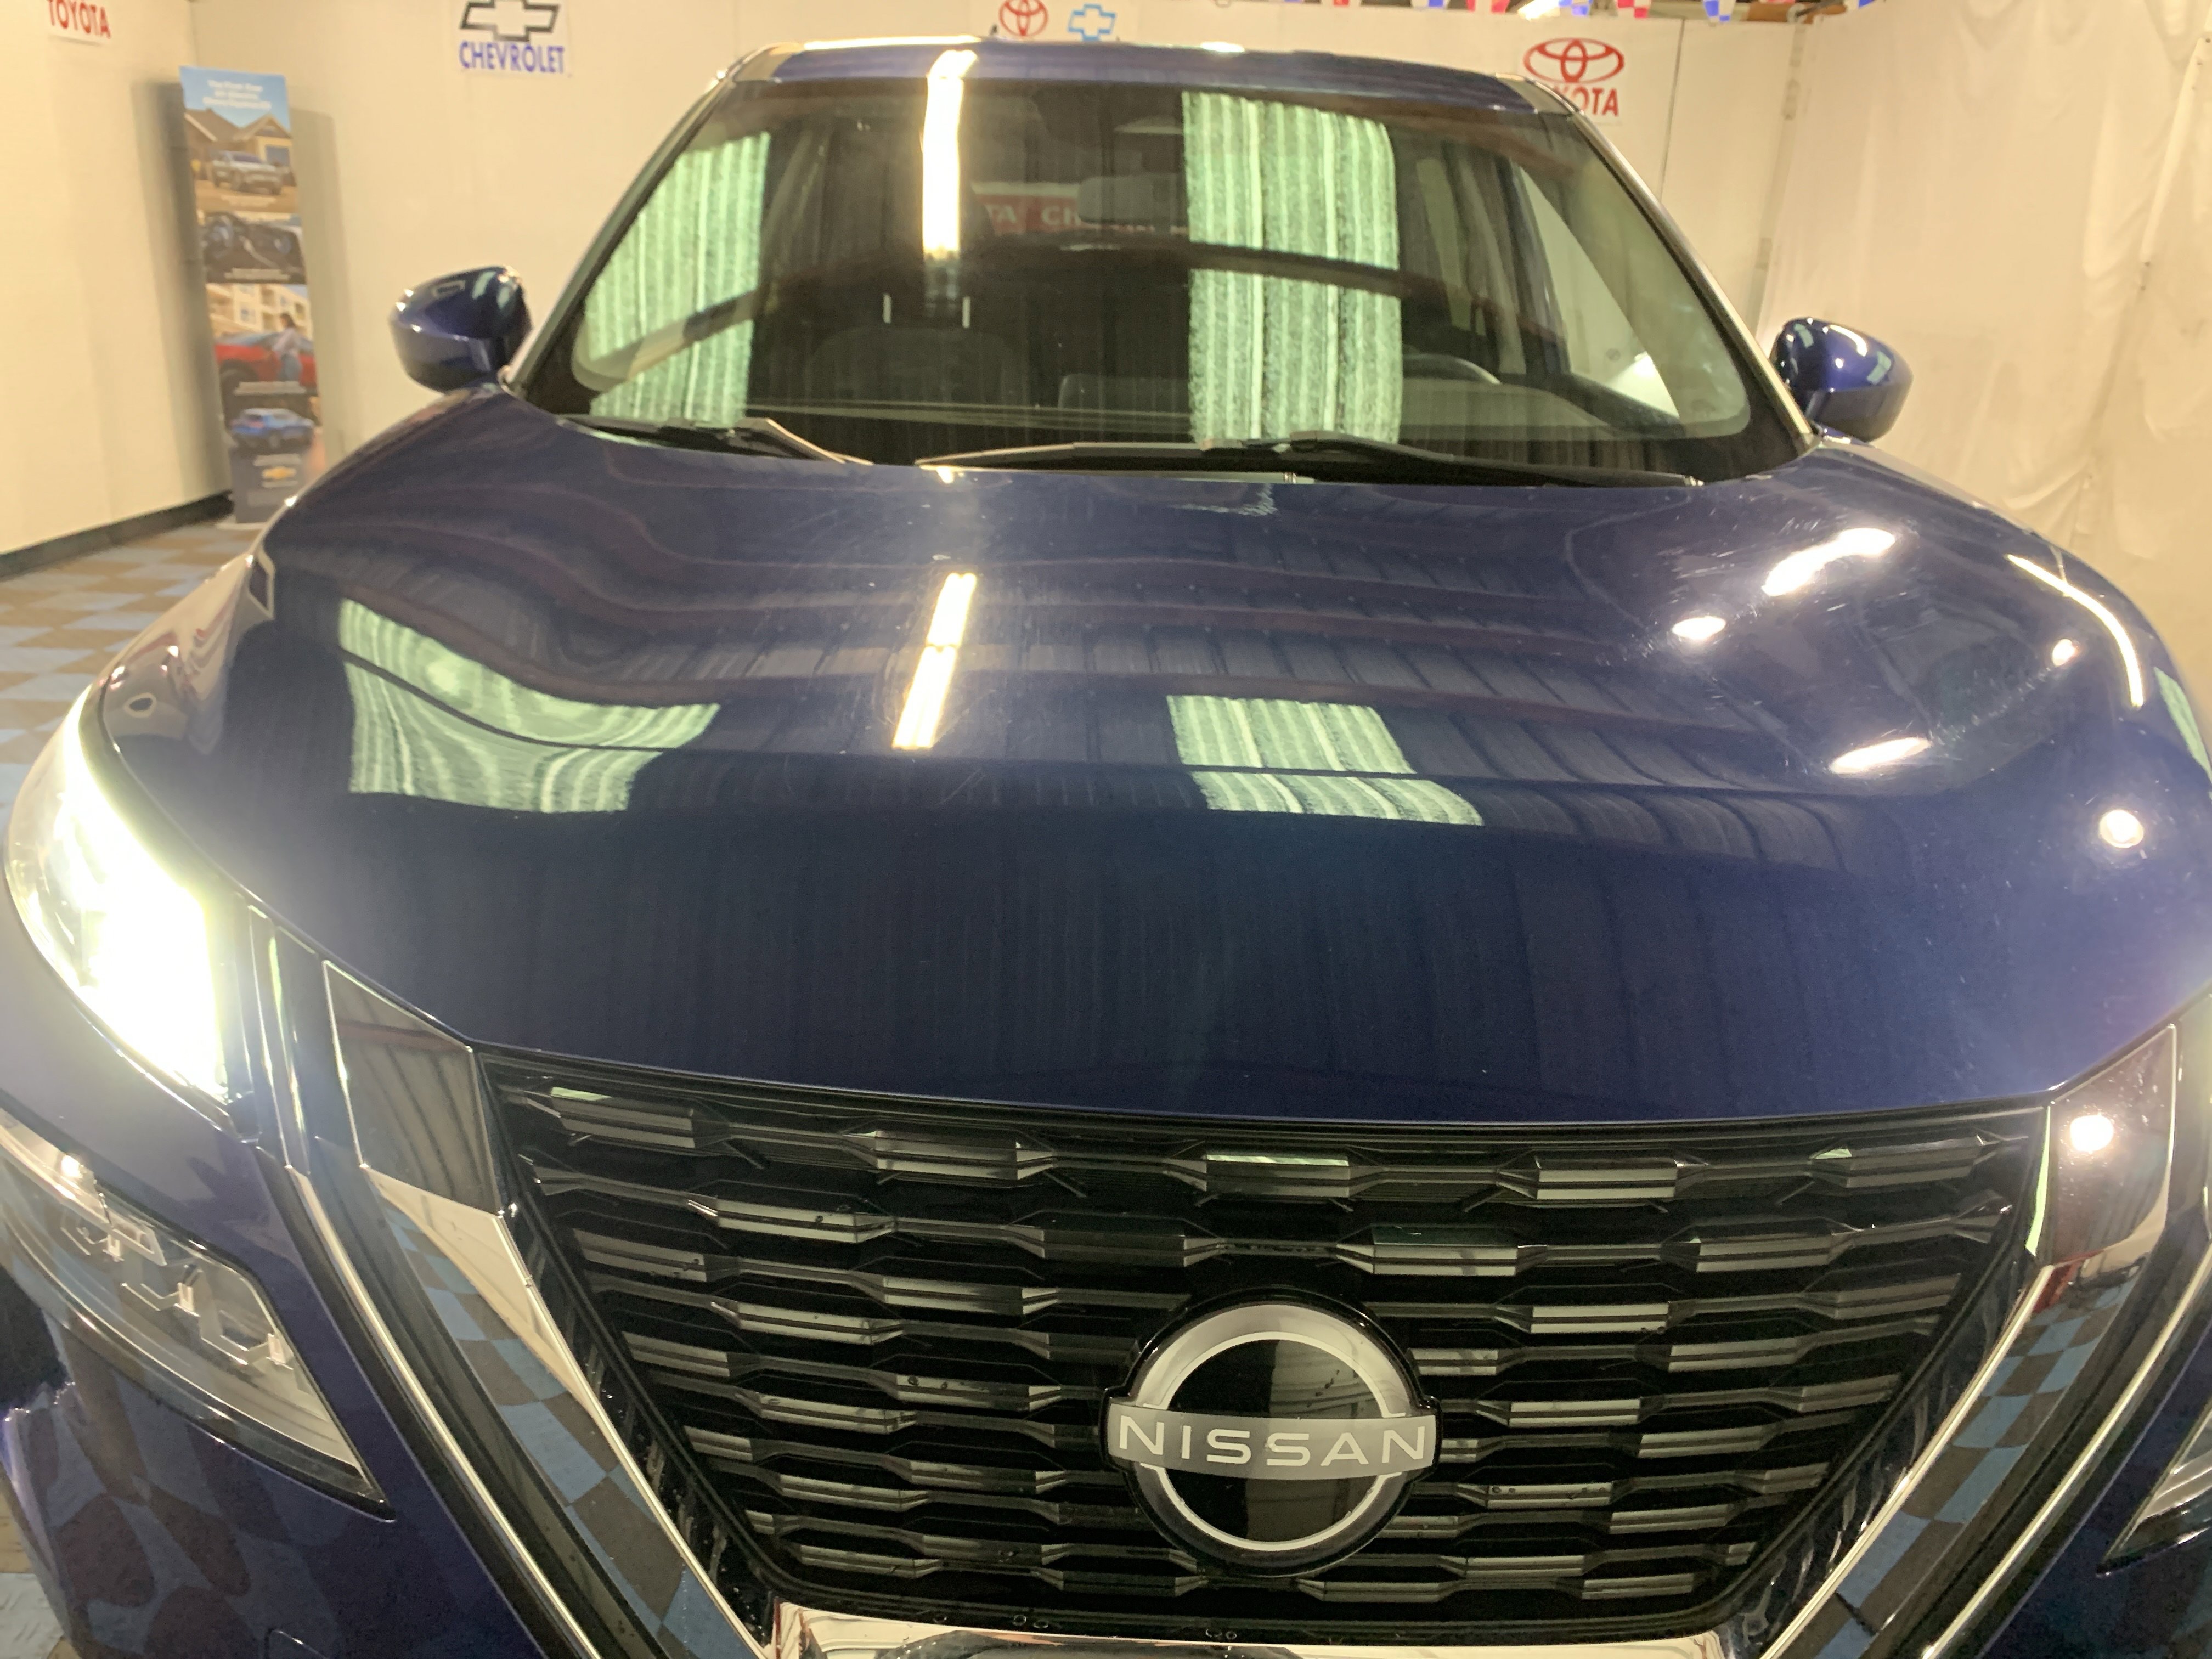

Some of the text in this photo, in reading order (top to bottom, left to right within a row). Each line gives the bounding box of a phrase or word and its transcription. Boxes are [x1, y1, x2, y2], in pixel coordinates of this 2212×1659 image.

[47, 0, 111, 39] TOYOTA
[459, 41, 565, 73] CHEVROLET
[1119, 1415, 1426, 1467] NISSAN
